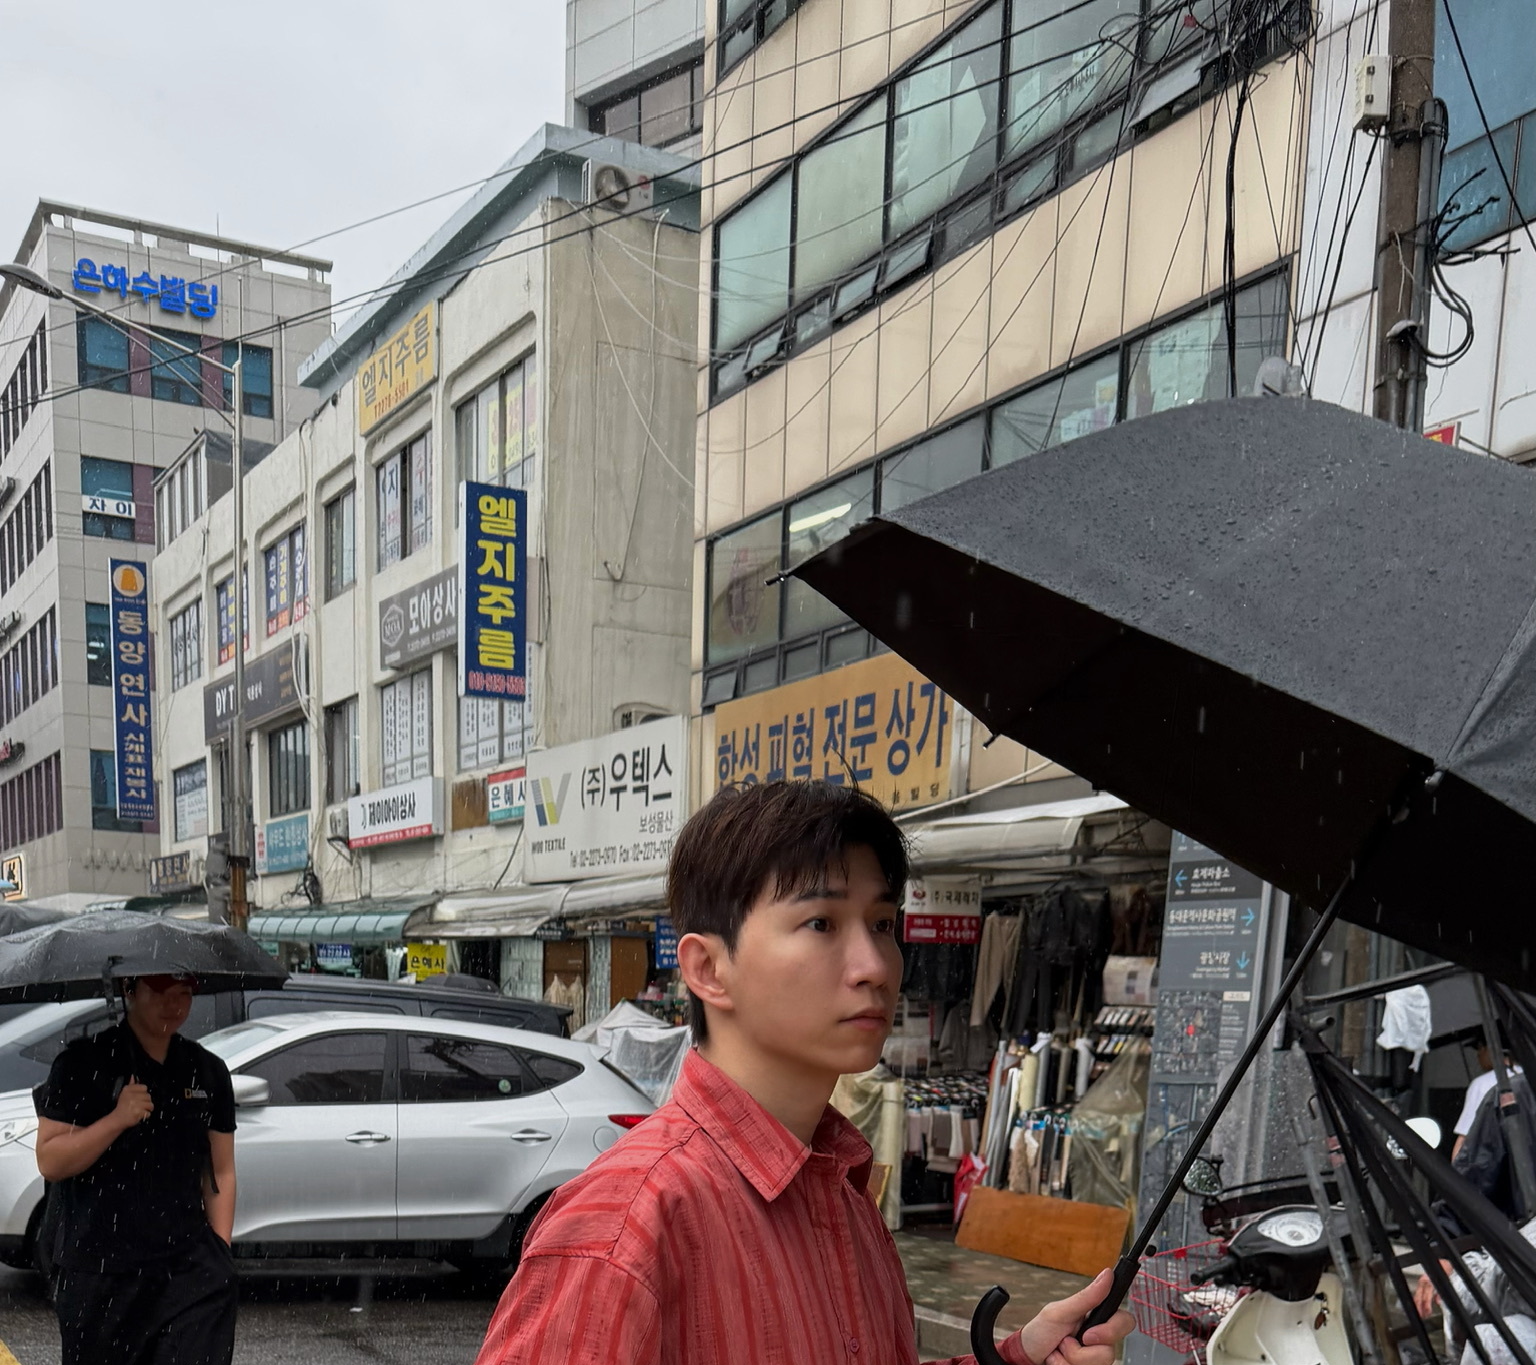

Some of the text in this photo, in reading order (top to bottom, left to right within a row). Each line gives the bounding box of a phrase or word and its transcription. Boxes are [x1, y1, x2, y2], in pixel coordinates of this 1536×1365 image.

[72, 257, 219, 319] 은하수빌딩
[362, 312, 431, 408] 엘지주름
[409, 577, 457, 636] 모아상사
[477, 495, 517, 670] 엘지주름
[117, 609, 148, 728] 동양연사
[581, 743, 673, 813] (주)우텍스
